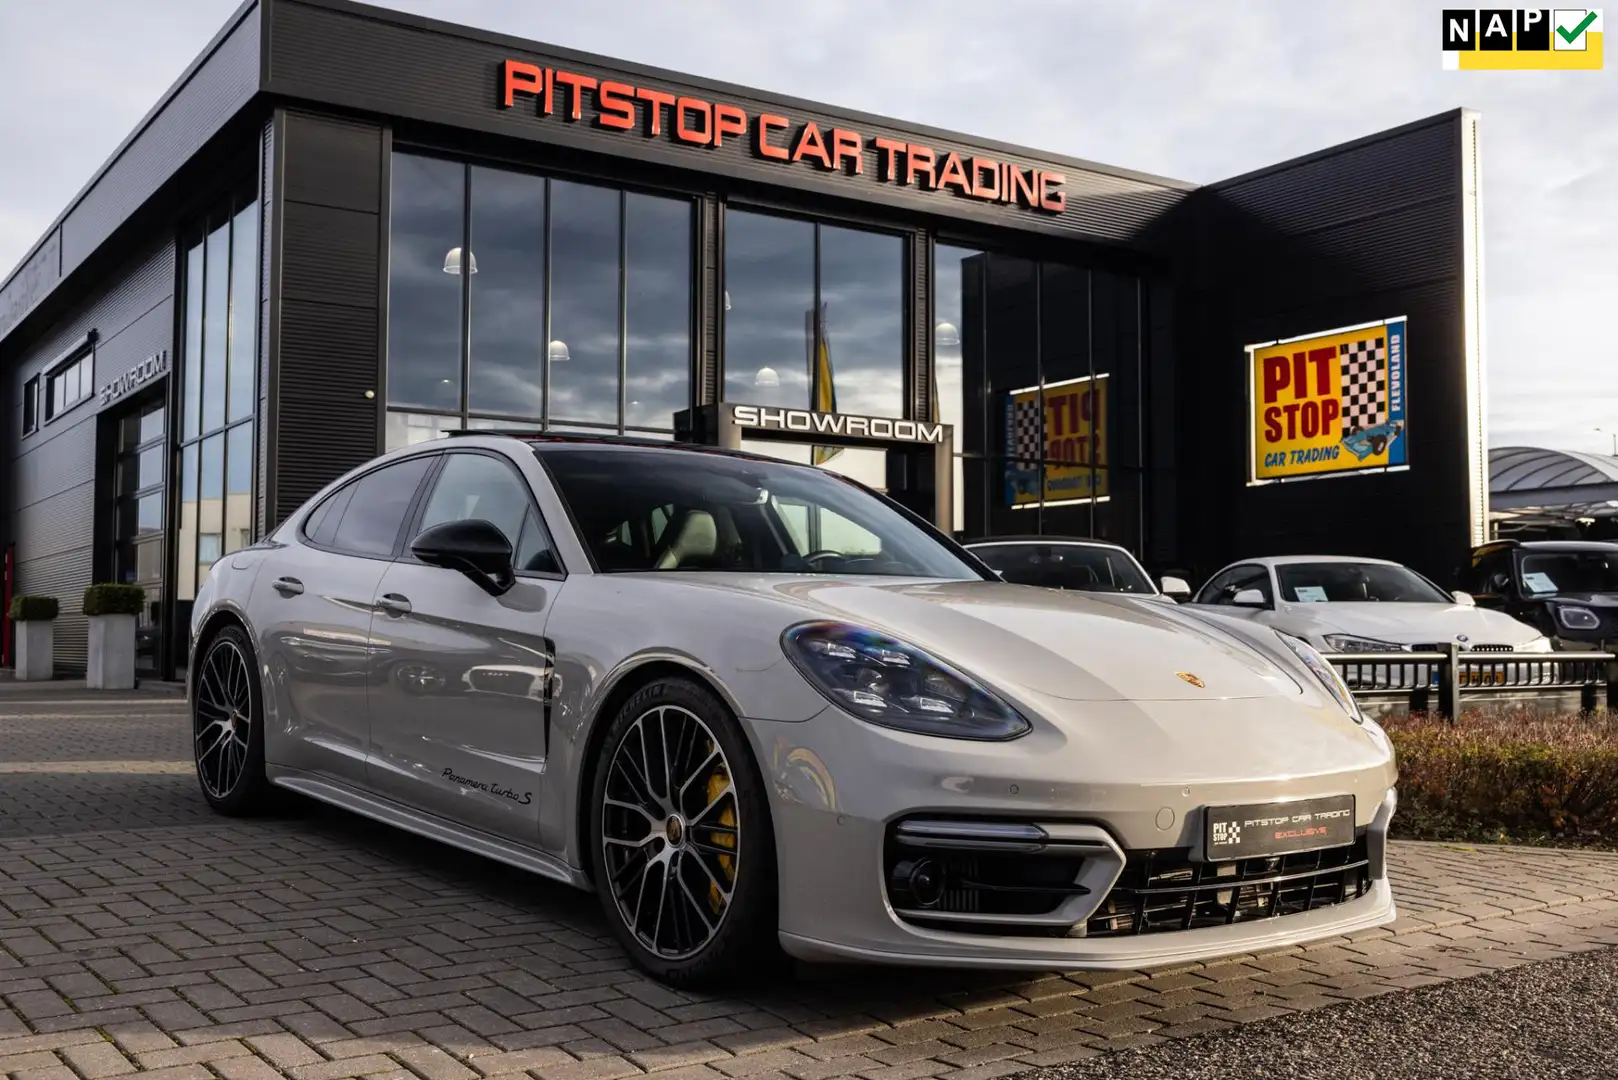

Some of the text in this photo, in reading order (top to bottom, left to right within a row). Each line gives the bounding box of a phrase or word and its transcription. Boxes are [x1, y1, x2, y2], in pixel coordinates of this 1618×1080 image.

[503, 59, 1067, 214] PITSTOP CAR TRADING
[1263, 346, 1337, 404] PIT
[1390, 335, 1400, 411] FLEVOLAND
[733, 405, 944, 443] SHOWROOM
[1263, 398, 1339, 443] STOP
[1264, 445, 1340, 468] CAR TRADING
[441, 767, 488, 792] Panamera
[491, 783, 519, 800] Turbo
[1213, 822, 1228, 833] PIT
[1244, 809, 1350, 827] PITSTOP CAR TRADING
[1213, 833, 1228, 842] STOP
